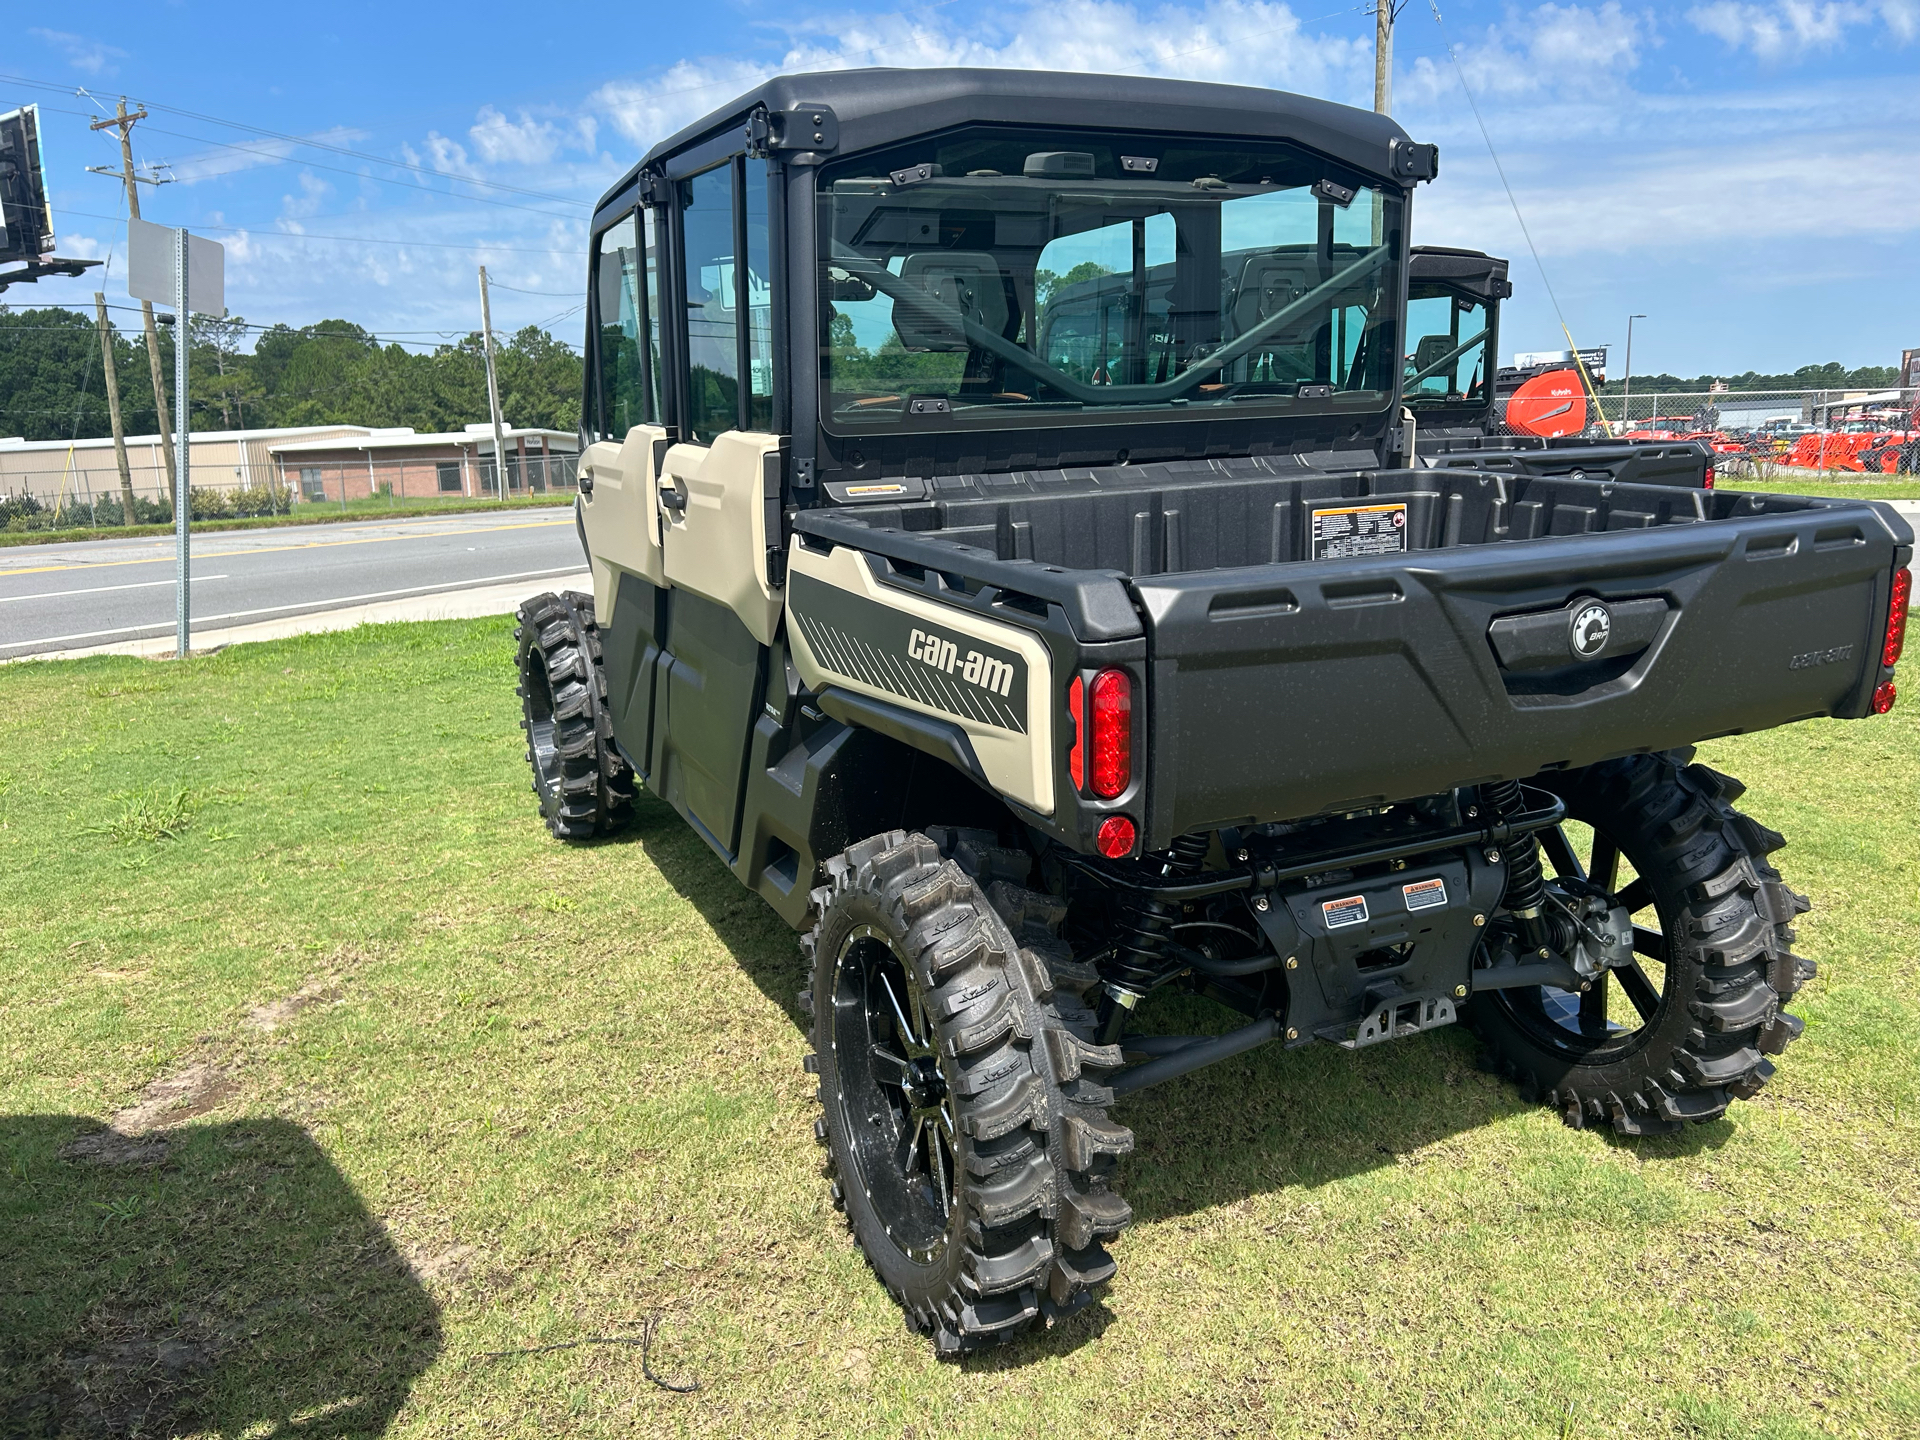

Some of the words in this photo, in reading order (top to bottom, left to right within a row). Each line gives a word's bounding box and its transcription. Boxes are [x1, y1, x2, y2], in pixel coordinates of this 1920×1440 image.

[1589, 631, 1608, 641] BRP
[907, 628, 1014, 697] can-am
[1415, 883, 1436, 891] WARNING
[1335, 900, 1357, 908] WARNING
